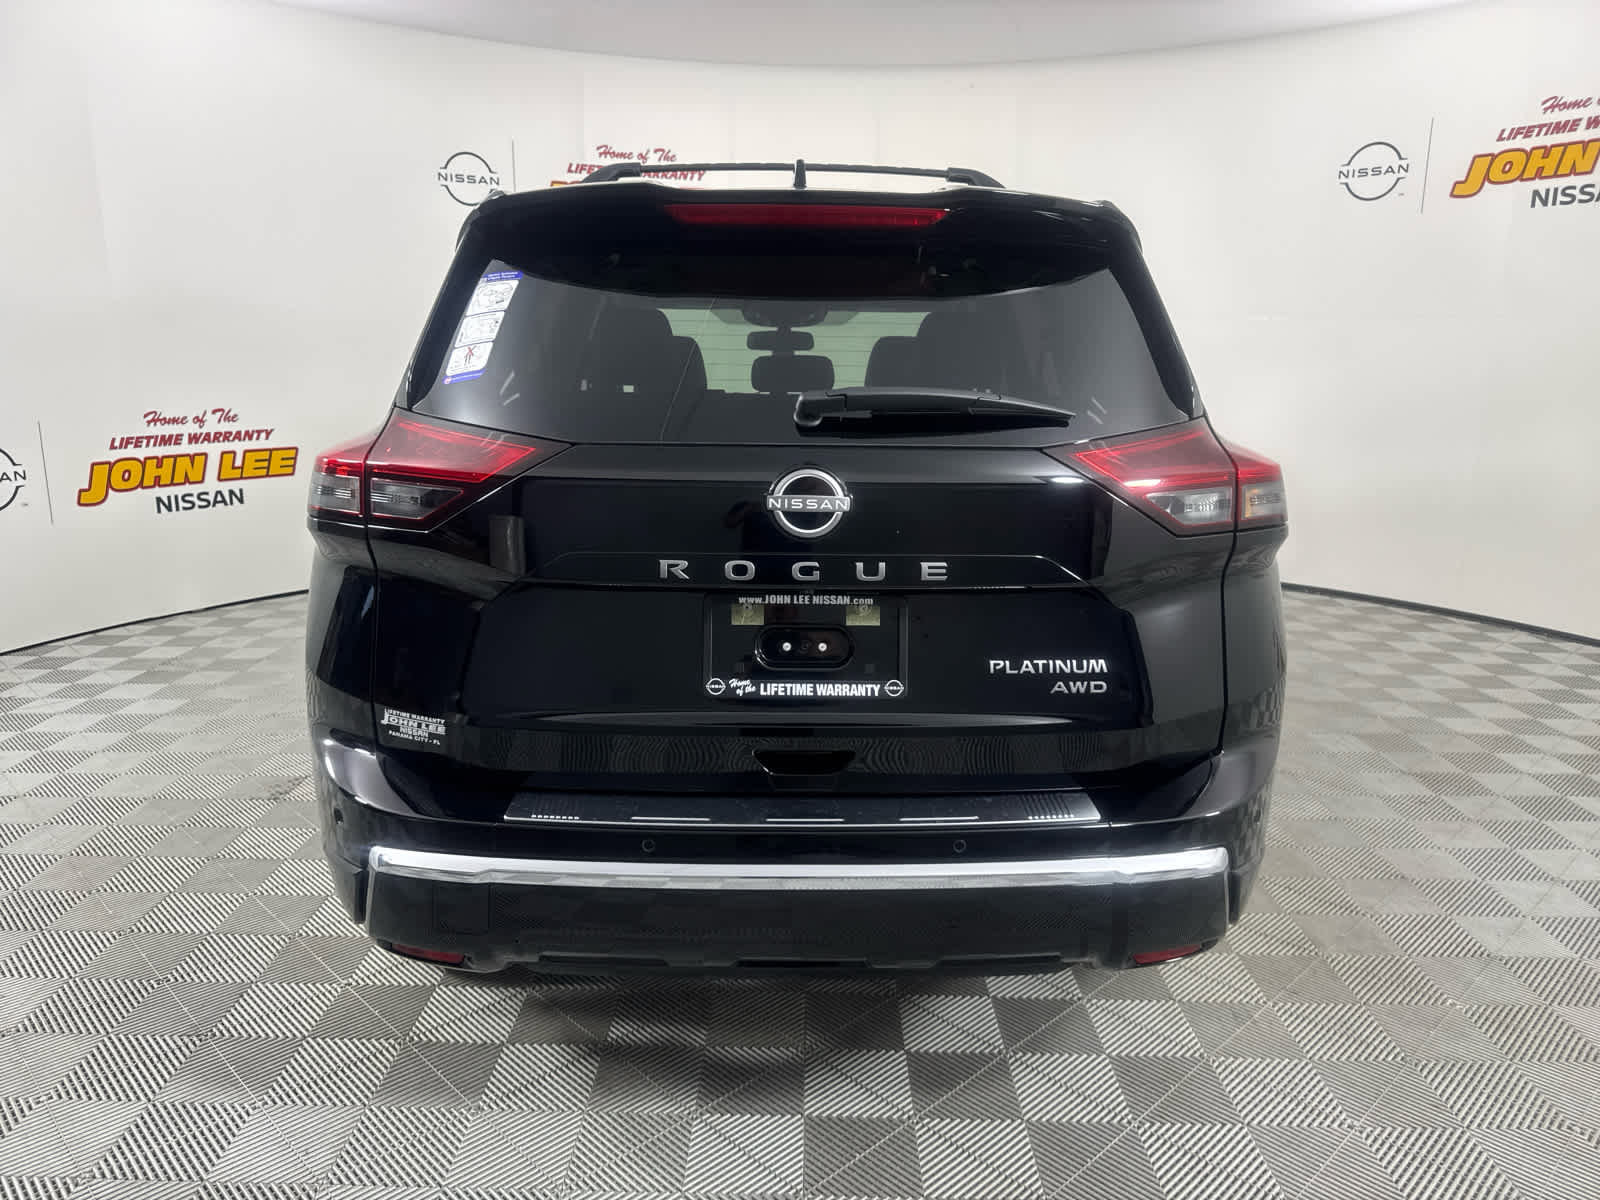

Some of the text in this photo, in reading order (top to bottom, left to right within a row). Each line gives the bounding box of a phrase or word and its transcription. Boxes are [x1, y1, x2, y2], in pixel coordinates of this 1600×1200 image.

[1541, 95, 1593, 114] Home
[1496, 117, 1583, 142] LIFETIME
[596, 145, 677, 163] Home of The
[1338, 163, 1409, 179] NISSAN
[1450, 138, 1600, 198] JOHN
[437, 171, 500, 186] NISSAN
[1531, 183, 1600, 208] NISS
[143, 408, 239, 427] Home of The
[109, 429, 274, 450] LIFETIME WARRANTY
[77, 447, 299, 507] JOHN LEE
[155, 488, 245, 514] NISSAN
[767, 497, 849, 511] NISSAN
[659, 559, 949, 582] ROGUE
[793, 595, 811, 604] LEE
[989, 659, 1108, 674] PLATINUM
[760, 683, 814, 696] LIFETIME
[816, 683, 881, 697] WARRANTY
[1050, 681, 1108, 694] AWD
[380, 712, 418, 728] JOHN
[400, 726, 429, 737] NISSAN
